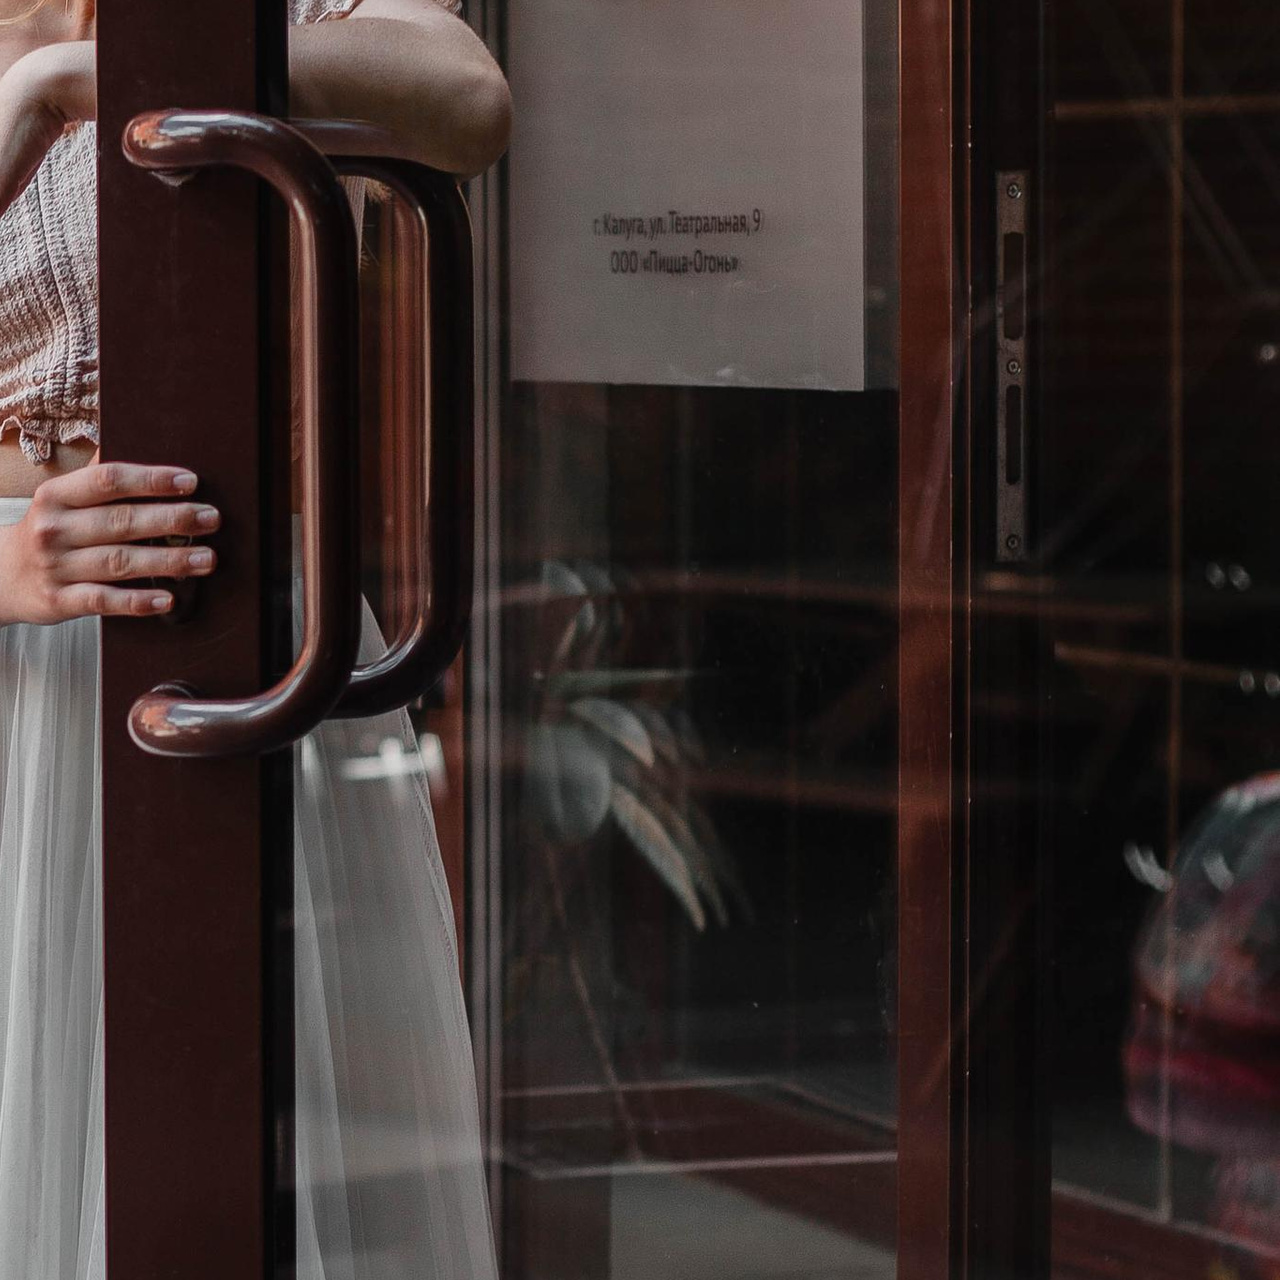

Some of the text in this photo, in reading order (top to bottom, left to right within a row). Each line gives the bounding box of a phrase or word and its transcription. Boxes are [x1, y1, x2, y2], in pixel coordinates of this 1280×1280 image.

[603, 213, 648, 241] Калуга,
[753, 208, 761, 233] 9
[611, 250, 639, 274] ООО
